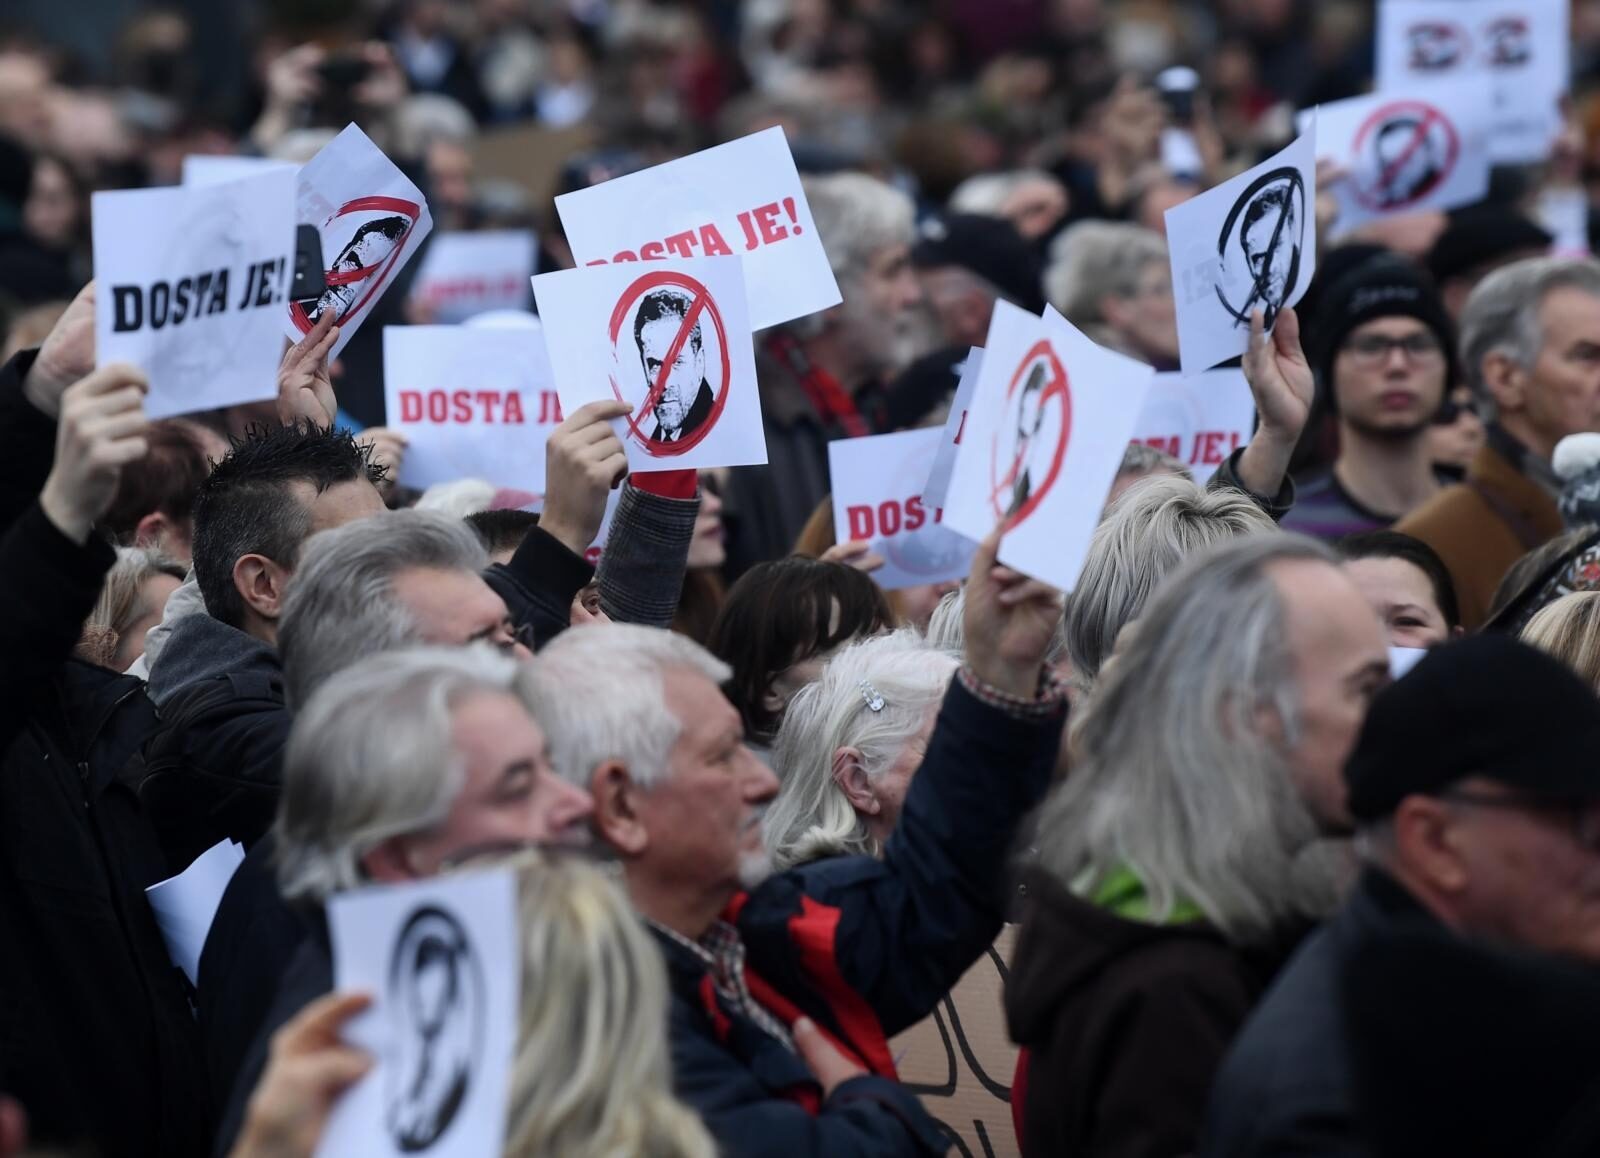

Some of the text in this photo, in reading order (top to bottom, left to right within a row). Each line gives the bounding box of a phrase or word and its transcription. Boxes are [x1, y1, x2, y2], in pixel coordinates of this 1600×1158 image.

[736, 196, 803, 251] JE!
[112, 256, 286, 332] DOSTA JE!
[399, 389, 564, 423] DOSTA J
